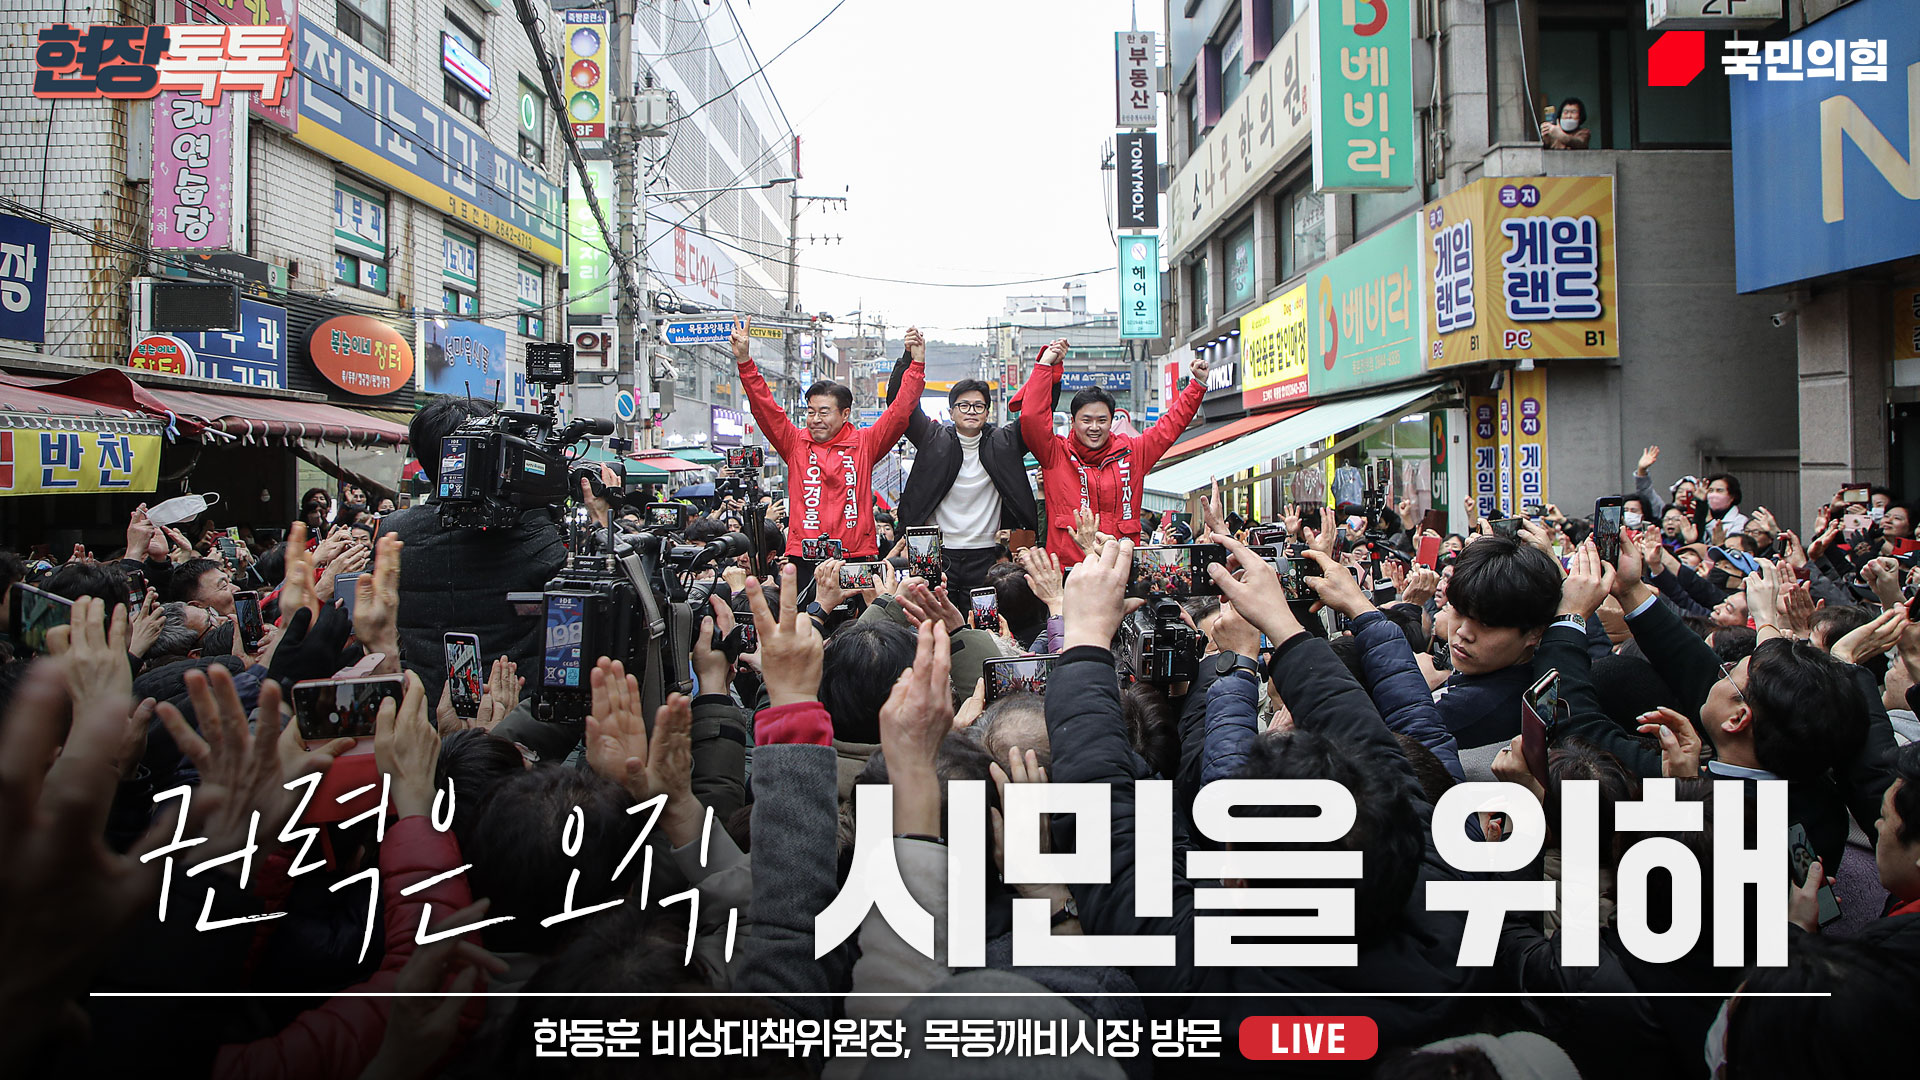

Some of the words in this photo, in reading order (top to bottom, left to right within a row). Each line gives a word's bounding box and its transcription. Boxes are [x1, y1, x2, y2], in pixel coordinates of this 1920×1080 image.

[1129, 47, 1150, 109] 부동산
[304, 28, 478, 198] 전비뇨기과
[494, 154, 558, 239] 피부과
[576, 125, 594, 136] 3F
[1340, 46, 1396, 179] 베비라
[171, 91, 215, 243] 래연습장
[1130, 138, 1144, 222] TONYMOLY
[1502, 189, 1536, 205] 코지
[688, 243, 719, 299] 다이소
[750, 328, 767, 336] CCTV
[1342, 265, 1413, 345] 베비라
[374, 340, 401, 372] 장터
[576, 331, 612, 367] 약
[1433, 340, 1444, 358] PC
[1470, 335, 1480, 351] B1
[1504, 329, 1532, 349] PC
[1585, 330, 1605, 346] B1
[39, 432, 134, 488] 반찬
[802, 466, 822, 530] 오경훈
